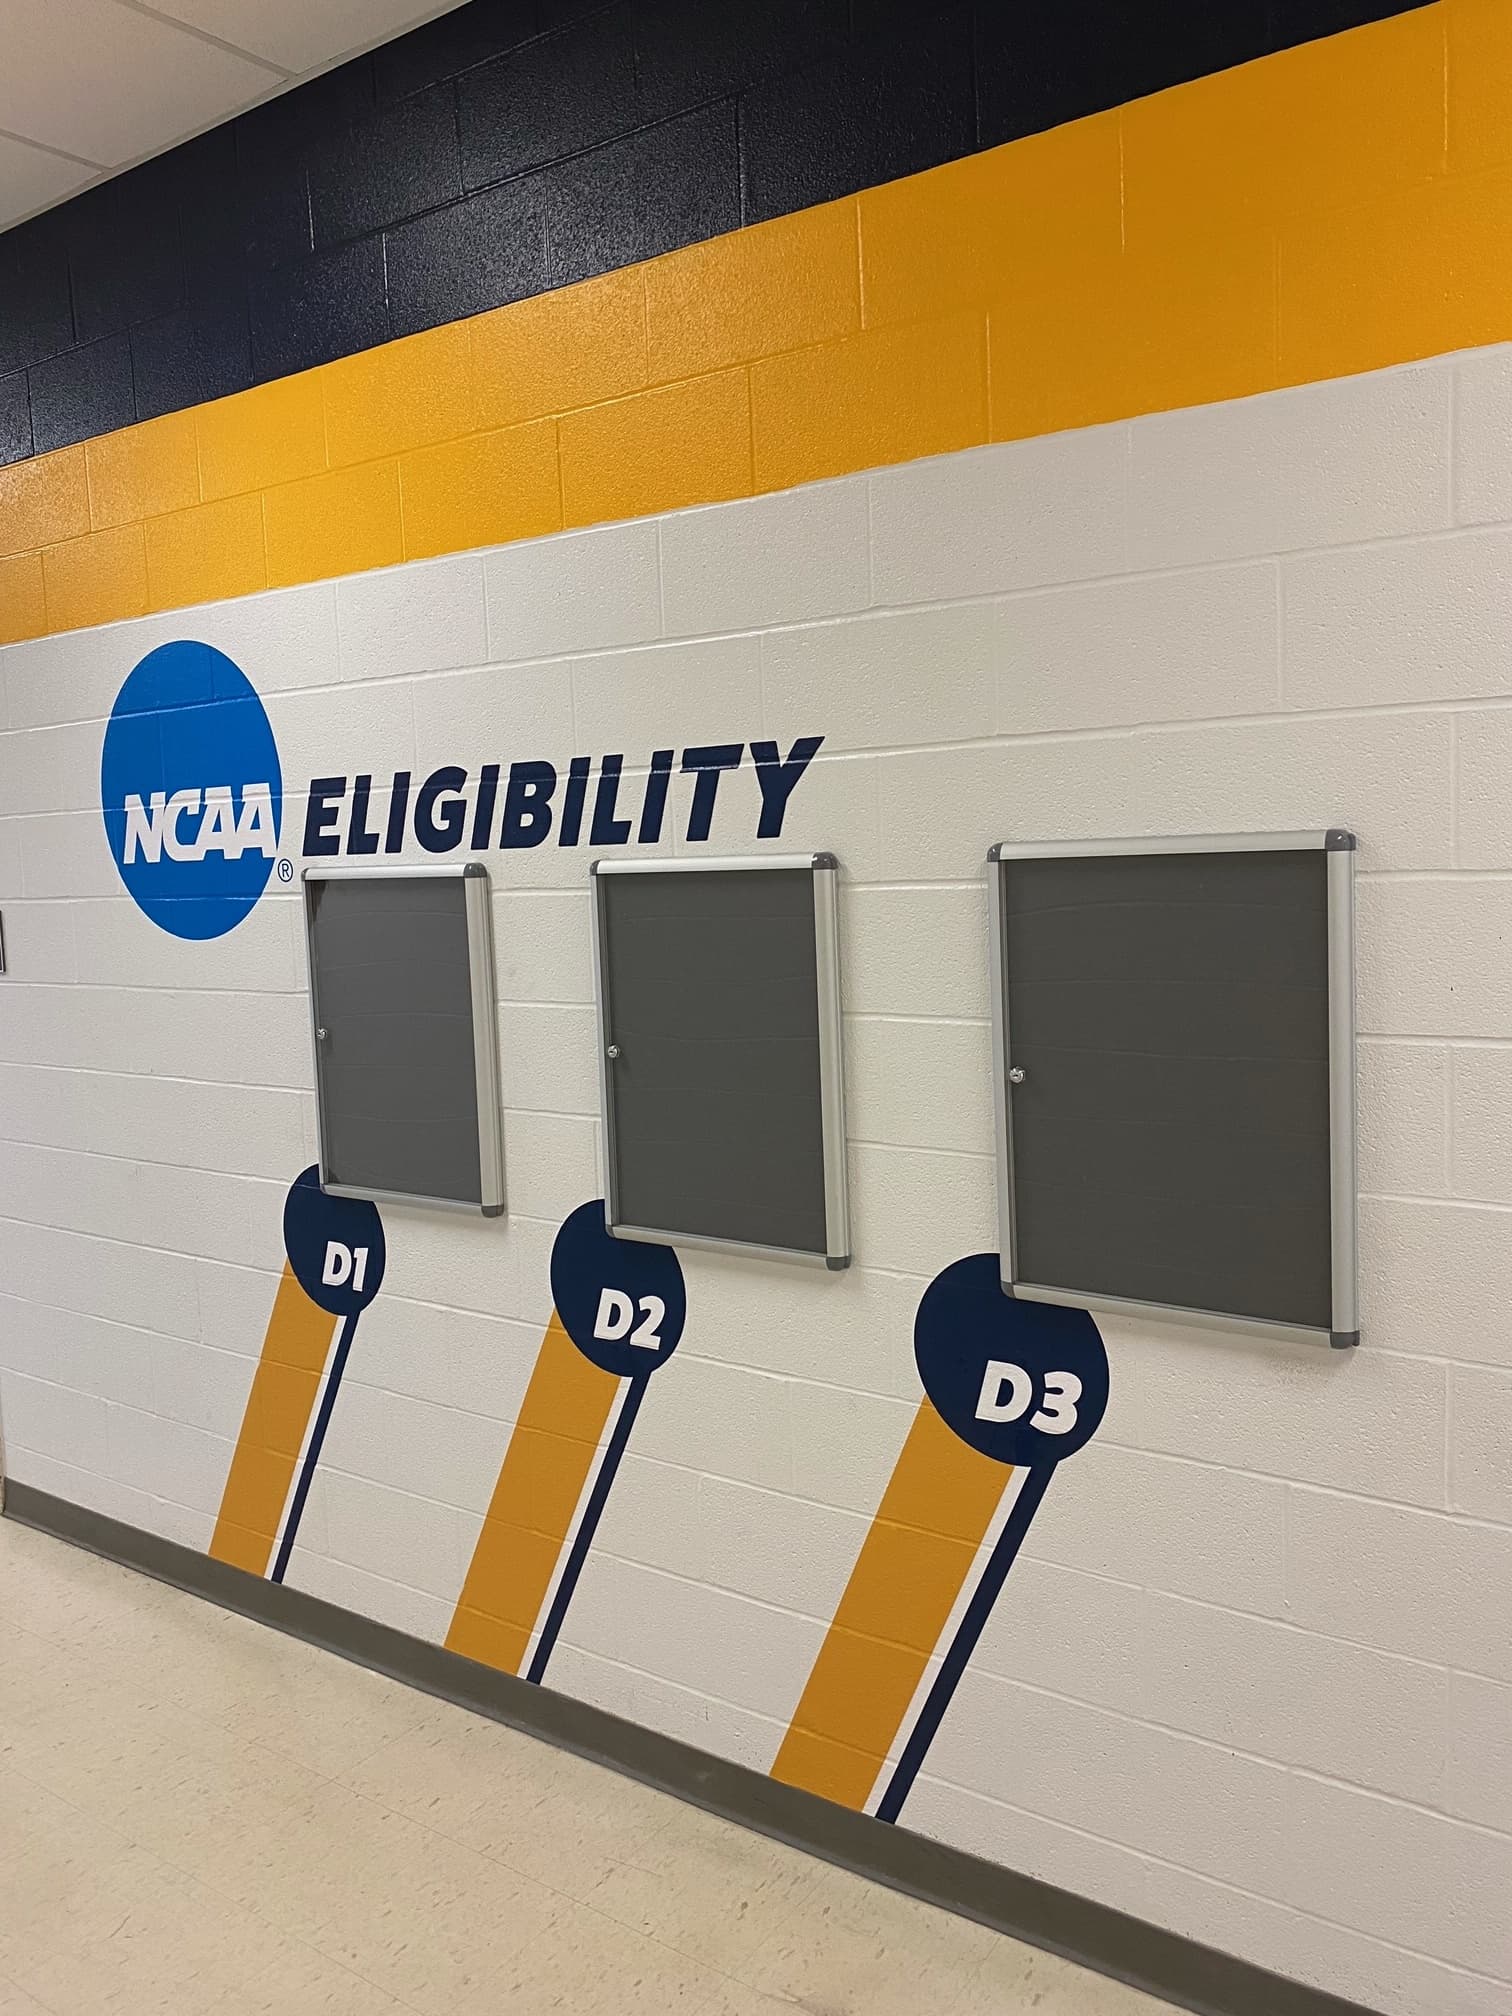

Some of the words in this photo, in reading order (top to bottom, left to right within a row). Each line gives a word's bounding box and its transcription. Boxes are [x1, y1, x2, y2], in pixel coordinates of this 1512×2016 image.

[122, 782, 277, 865] NCAA
[301, 735, 826, 857] ELIGIBILITY
[321, 1240, 369, 1293] D1
[593, 1287, 666, 1351] D2
[974, 1359, 1083, 1436] D3
